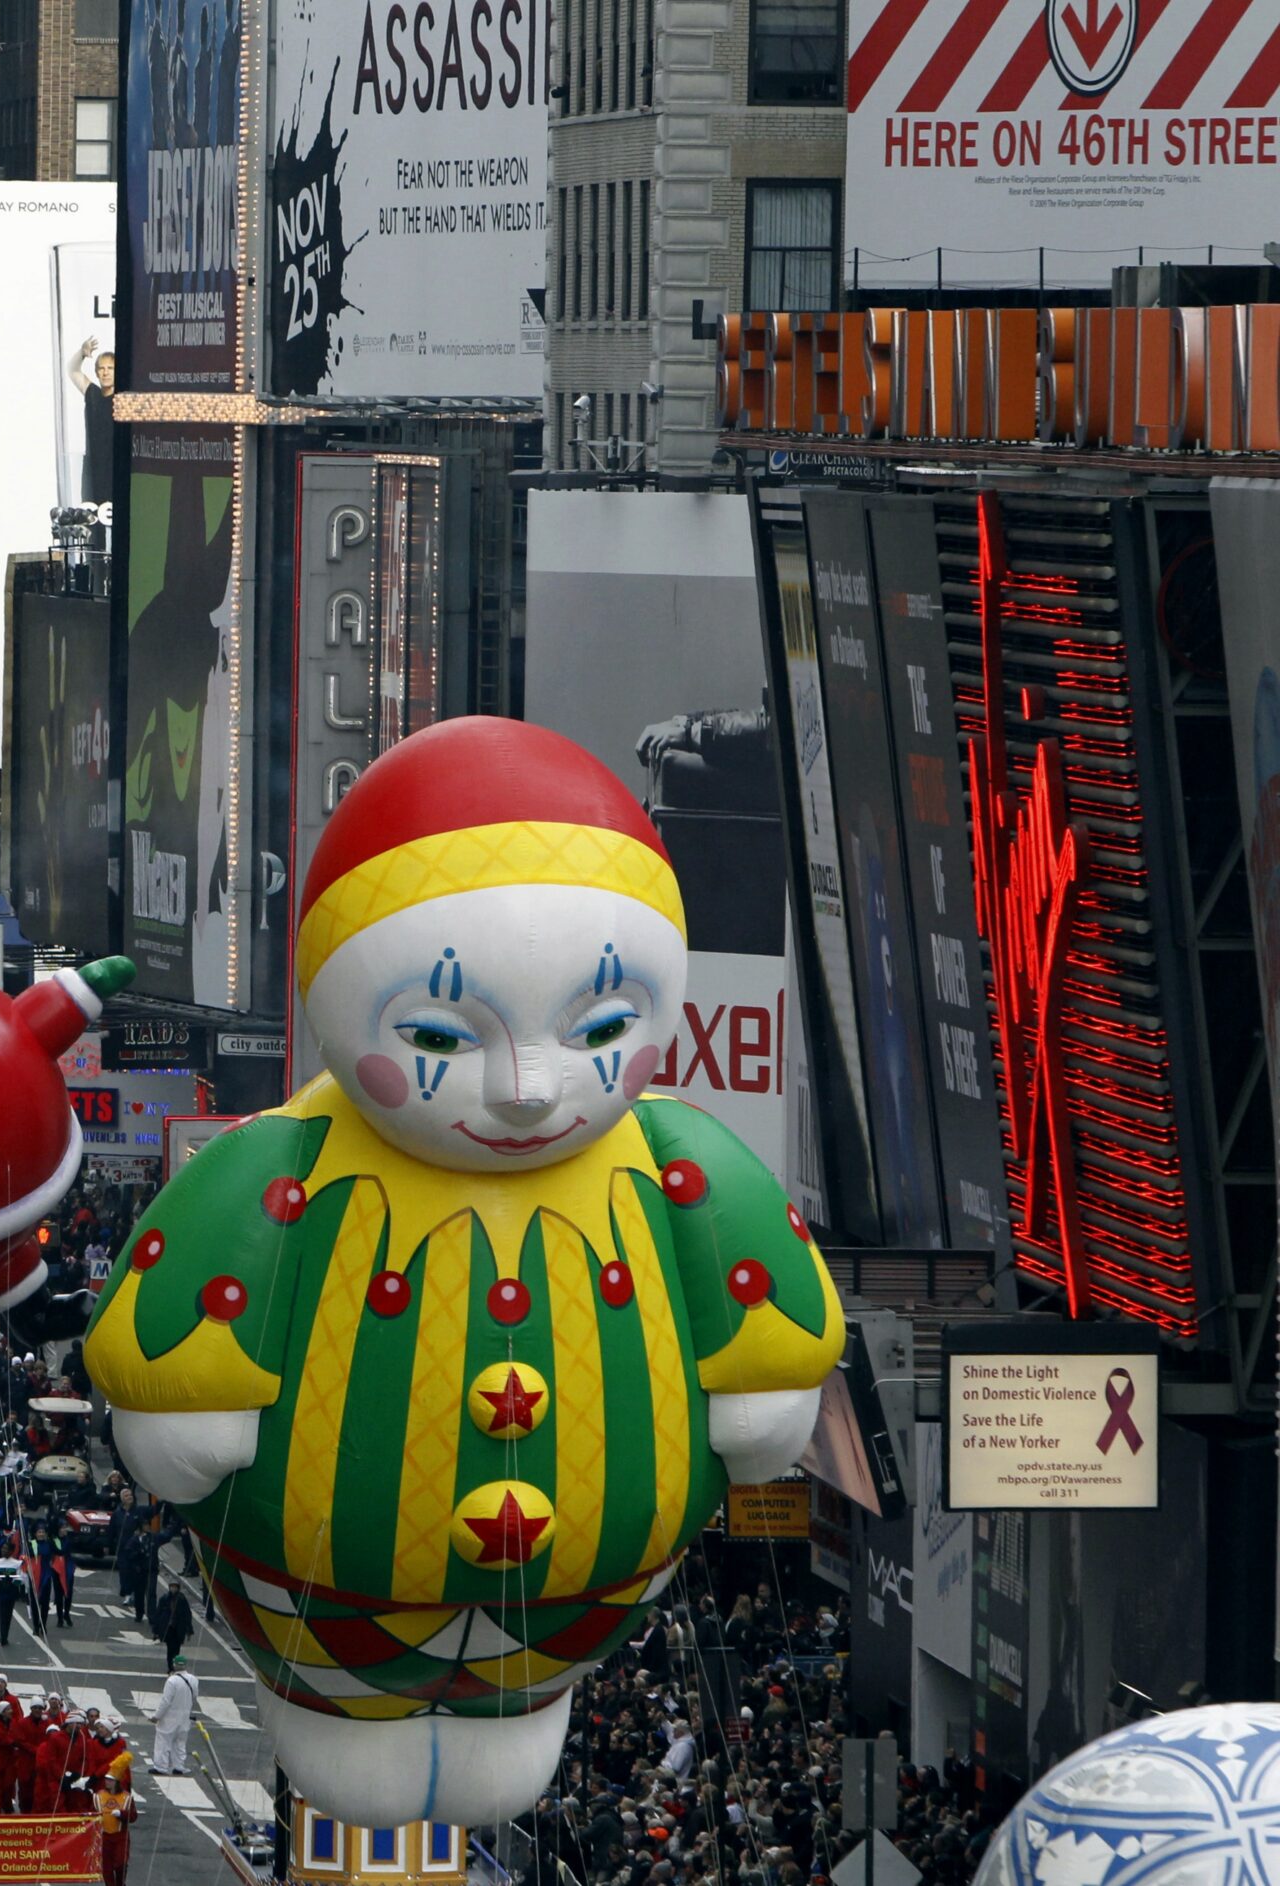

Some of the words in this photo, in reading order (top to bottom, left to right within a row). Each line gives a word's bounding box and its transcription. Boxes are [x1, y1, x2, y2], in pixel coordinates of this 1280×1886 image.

[353, 0, 549, 115] ASSASSI
[885, 117, 977, 167] HERE
[992, 119, 1042, 166] ON
[1058, 114, 1149, 166] 46TH
[1164, 118, 1280, 165] STREE
[397, 157, 423, 190] FEAR
[427, 160, 450, 189] NOT
[453, 158, 474, 188] THE
[477, 156, 528, 188] WEAPON
[18, 201, 79, 213] ROMANO
[143, 148, 201, 274] JERSEY
[278, 173, 327, 263] NOV
[379, 206, 398, 235] BUT
[402, 205, 421, 235] THE
[424, 204, 457, 234] HAND
[460, 203, 487, 233] THAT
[490, 203, 530, 232] WIELDS
[282, 244, 331, 342] 25TH
[158, 293, 182, 320] BEST
[183, 291, 225, 319] MUSICAL
[1038, 304, 1280, 450] BUILDIN
[930, 932, 970, 1009] POWER
[124, 1021, 189, 1044] TADS
[230, 1038, 251, 1052] city
[650, 988, 785, 1096] xel
[962, 1365, 998, 1380] Shine
[1001, 1365, 1022, 1380] the
[1026, 1365, 1059, 1382] Light
[962, 1390, 978, 1401] on
[982, 1387, 1039, 1401] Domestic
[1043, 1387, 1097, 1401] Violence
[962, 1414, 992, 1428] Save
[995, 1413, 1016, 1428] the
[1020, 1413, 1044, 1428] Life
[962, 1435, 977, 1449] of
[980, 1438, 986, 1449] a
[989, 1436, 1016, 1449] New
[1019, 1436, 1060, 1449] Yorker
[1017, 1461, 1102, 1473] opdv.state.ny.us
[998, 1474, 1122, 1487] mbpo.org/DVawareness
[1040, 1488, 1058, 1498] call
[1061, 1488, 1079, 1498] 311
[742, 1499, 796, 1508] COMPUTERS
[748, 1512, 790, 1520] LUGGAGE
[35, 1826, 52, 1836] Day
[55, 1825, 87, 1834] Parade
[20, 1850, 51, 1860] SANTA
[2, 1863, 38, 1872] Orlando
[40, 1863, 70, 1872] Resort
